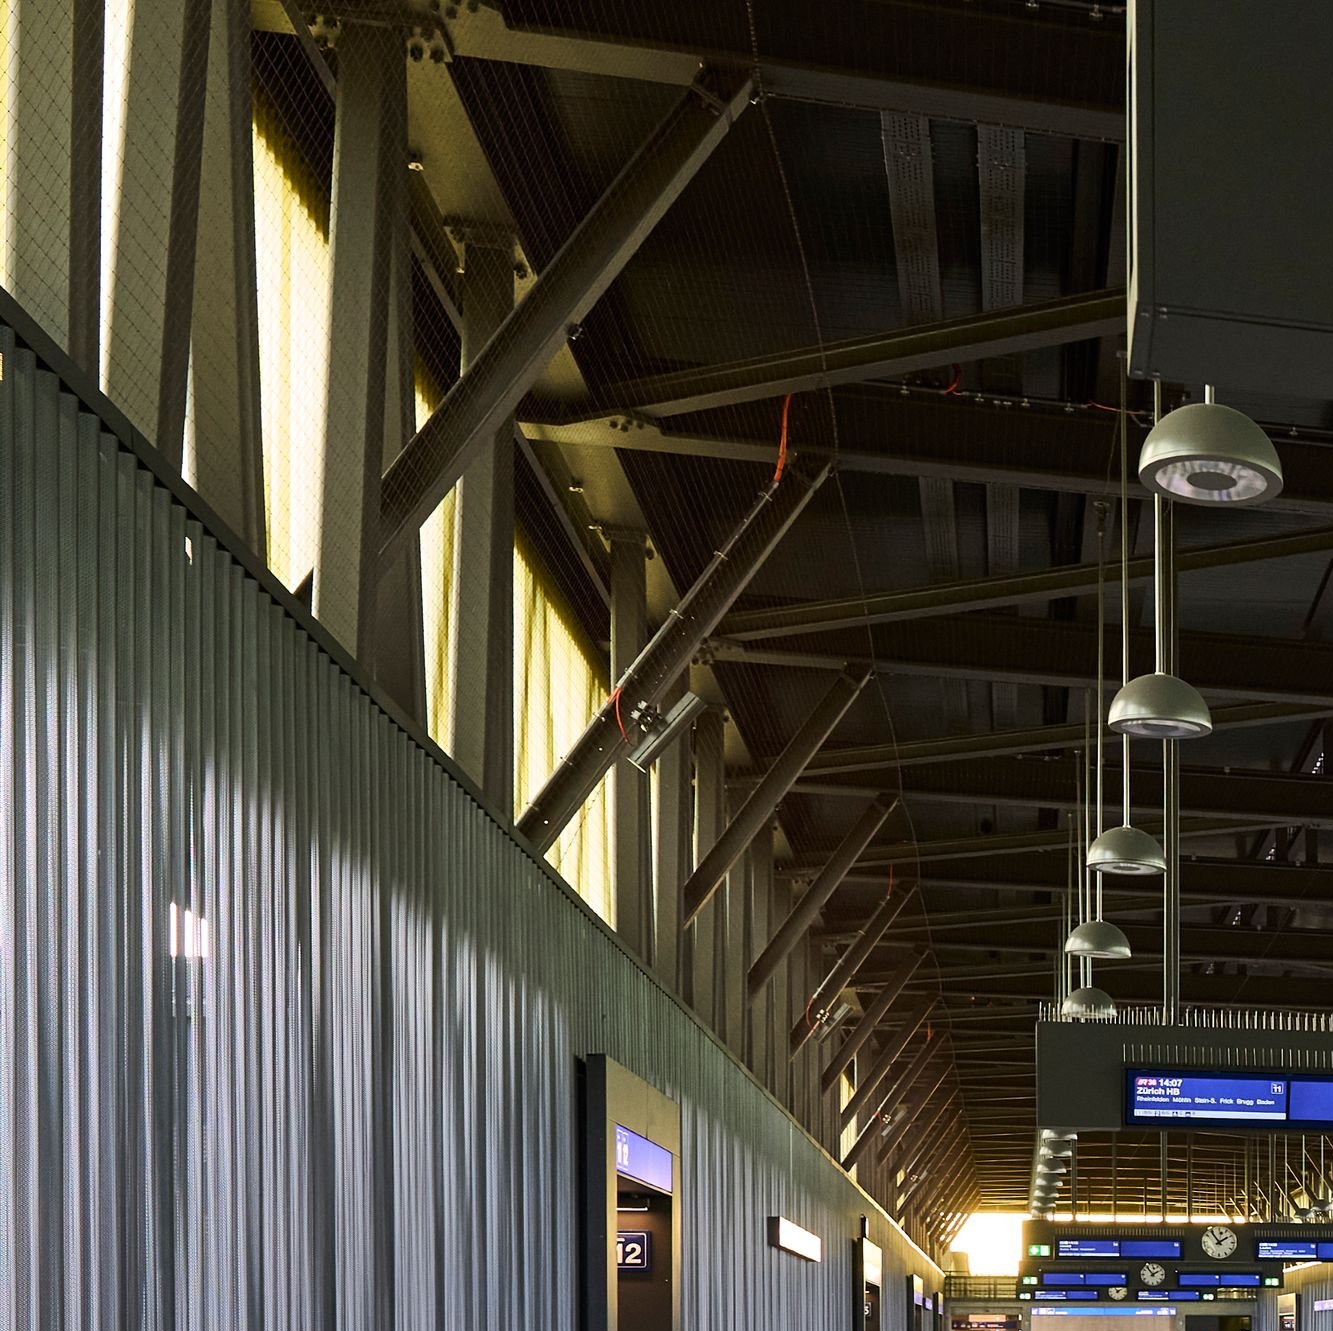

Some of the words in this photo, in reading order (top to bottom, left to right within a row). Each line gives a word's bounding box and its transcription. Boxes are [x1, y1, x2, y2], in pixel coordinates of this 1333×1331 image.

[1159, 1078, 1183, 1087] 14:07
[1136, 1086, 1165, 1095] Zürich
[1166, 1088, 1181, 1096] HB
